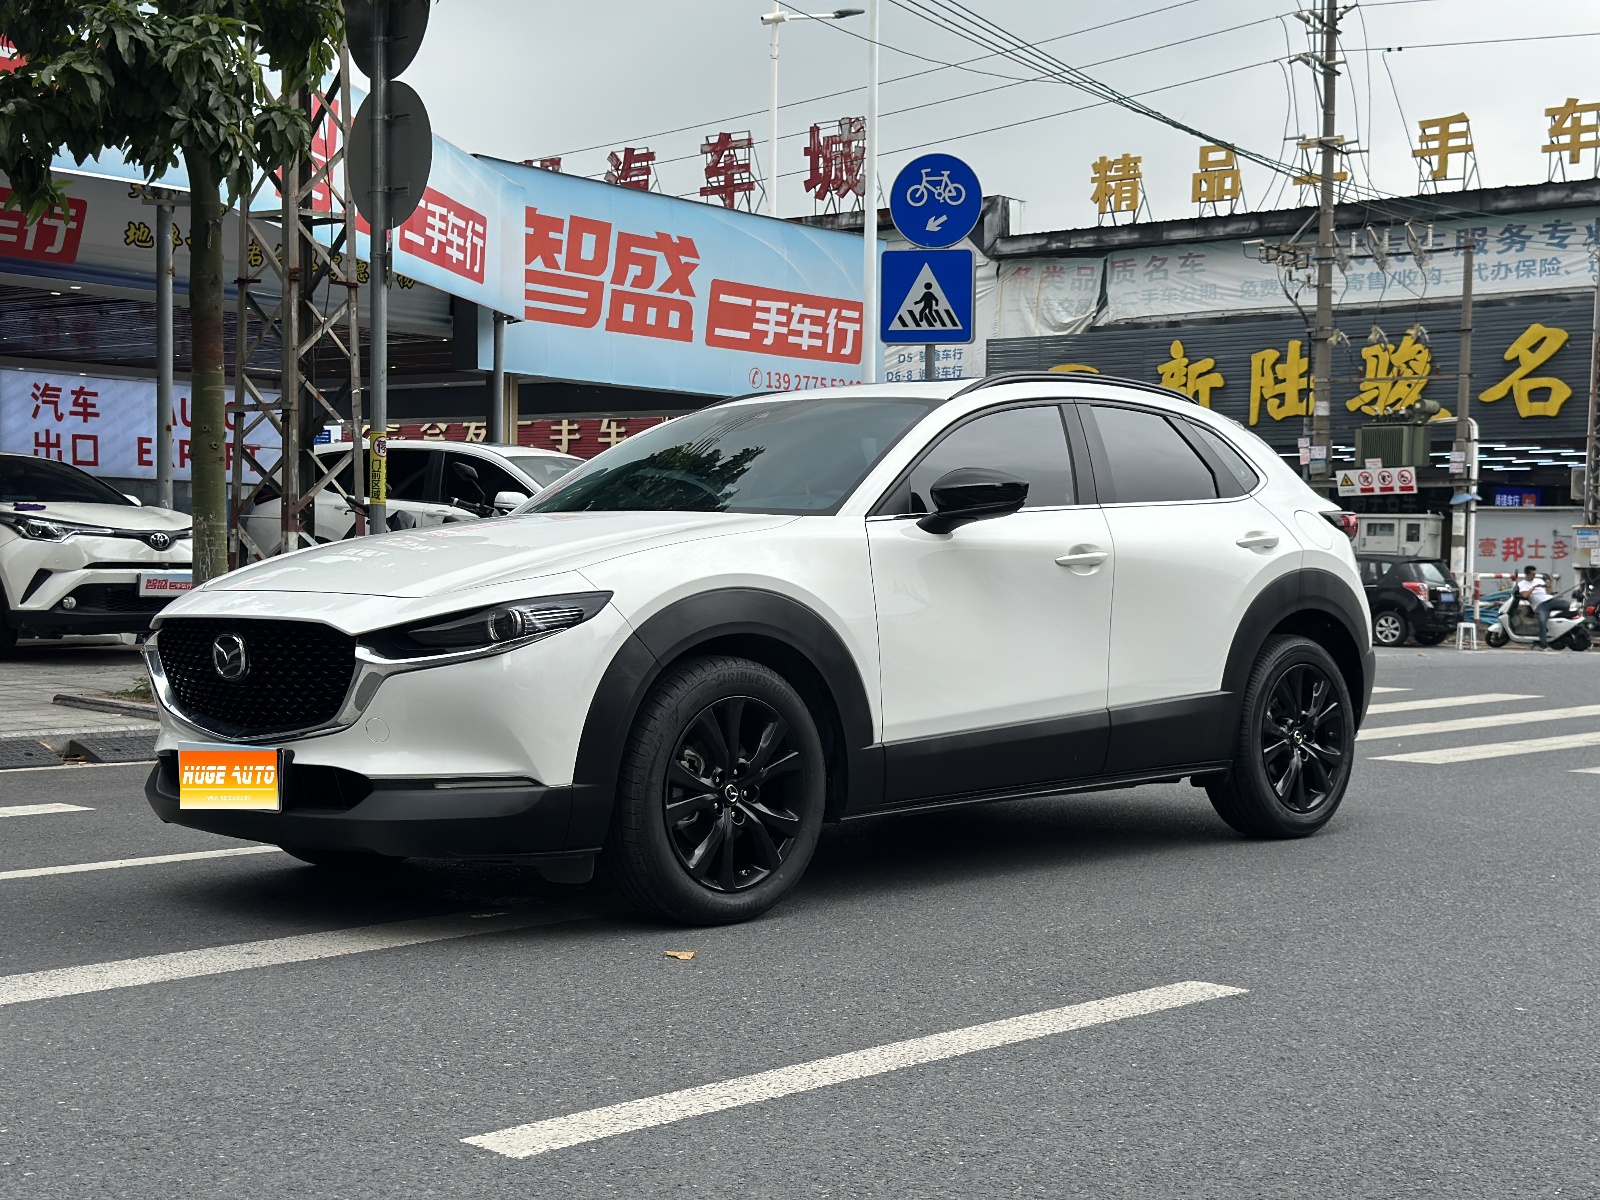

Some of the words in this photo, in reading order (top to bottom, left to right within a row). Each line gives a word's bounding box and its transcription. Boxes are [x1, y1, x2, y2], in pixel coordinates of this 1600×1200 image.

[525, 205, 702, 343] 智盛
[713, 294, 862, 356] 二手车行
[898, 353, 913, 363] D5
[766, 371, 791, 390] 139
[886, 370, 913, 381] D6-8
[30, 382, 100, 423] 汽车
[33, 428, 99, 467] 出口
[1477, 536, 1569, 562] 壹邦士多
